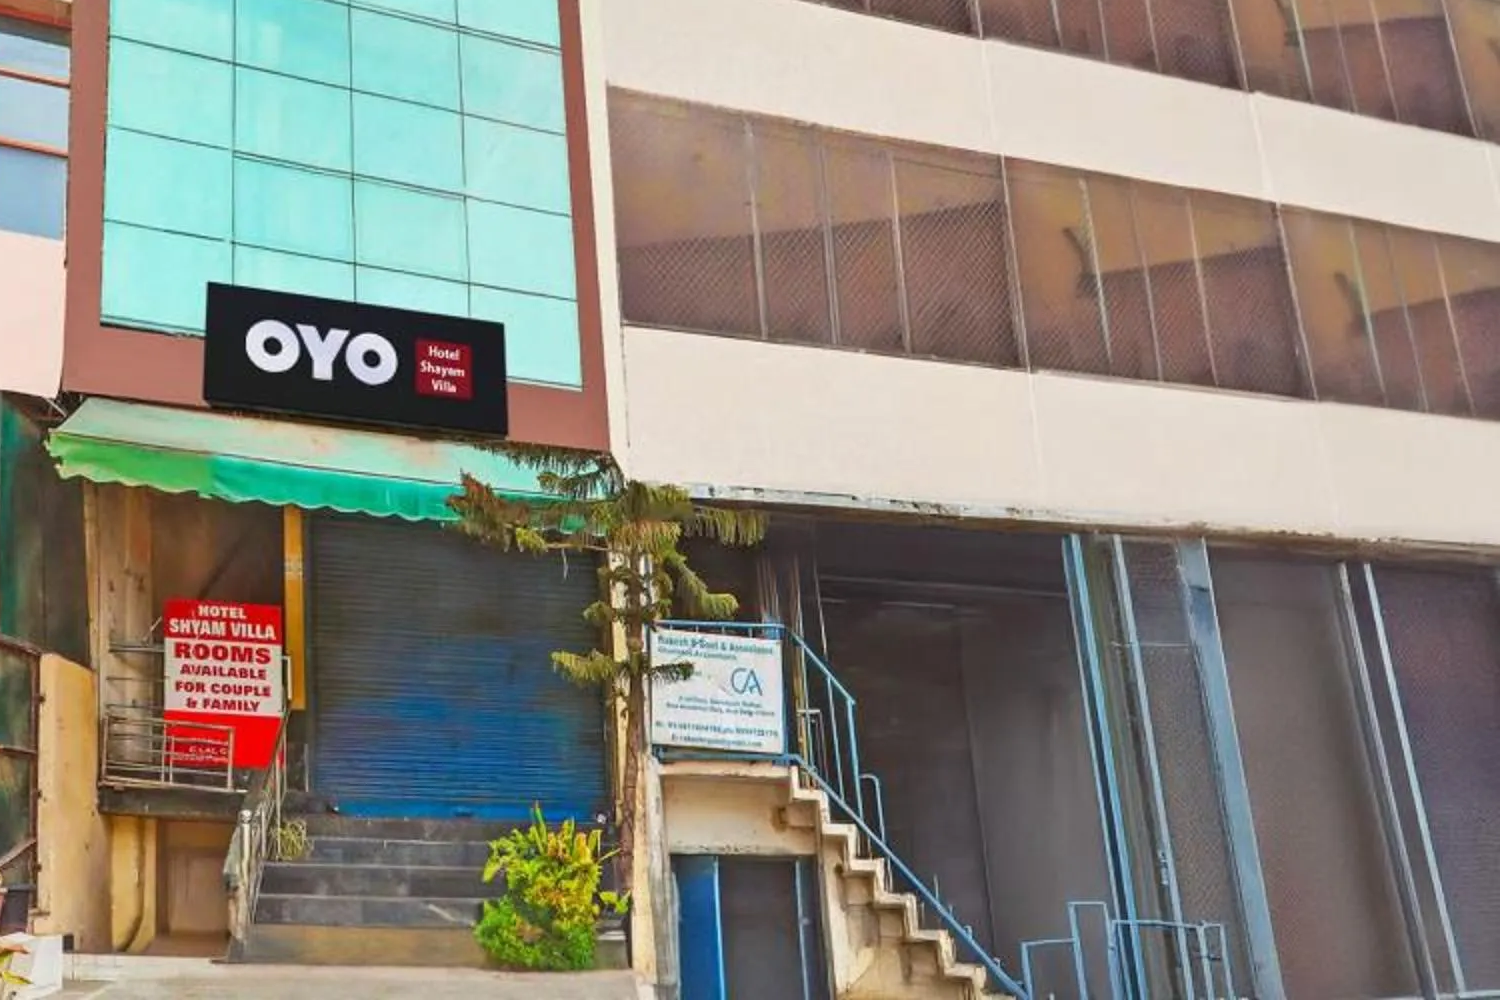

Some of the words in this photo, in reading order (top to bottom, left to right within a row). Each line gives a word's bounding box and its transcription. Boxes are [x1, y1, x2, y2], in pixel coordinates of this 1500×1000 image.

[245, 319, 399, 386] OYO
[428, 345, 461, 361] Hotel
[419, 360, 466, 378] Shayam
[431, 378, 457, 394] Villa
[197, 604, 247, 620] HOTEL
[168, 617, 227, 637] SHYAM
[230, 621, 277, 640] VILLA
[173, 641, 272, 665] ROOMS
[180, 663, 267, 680] AVAILABLE
[174, 681, 206, 694] FOR
[210, 683, 272, 698] COUPLE
[185, 697, 198, 709] &
[203, 699, 261, 712] FAMILY
